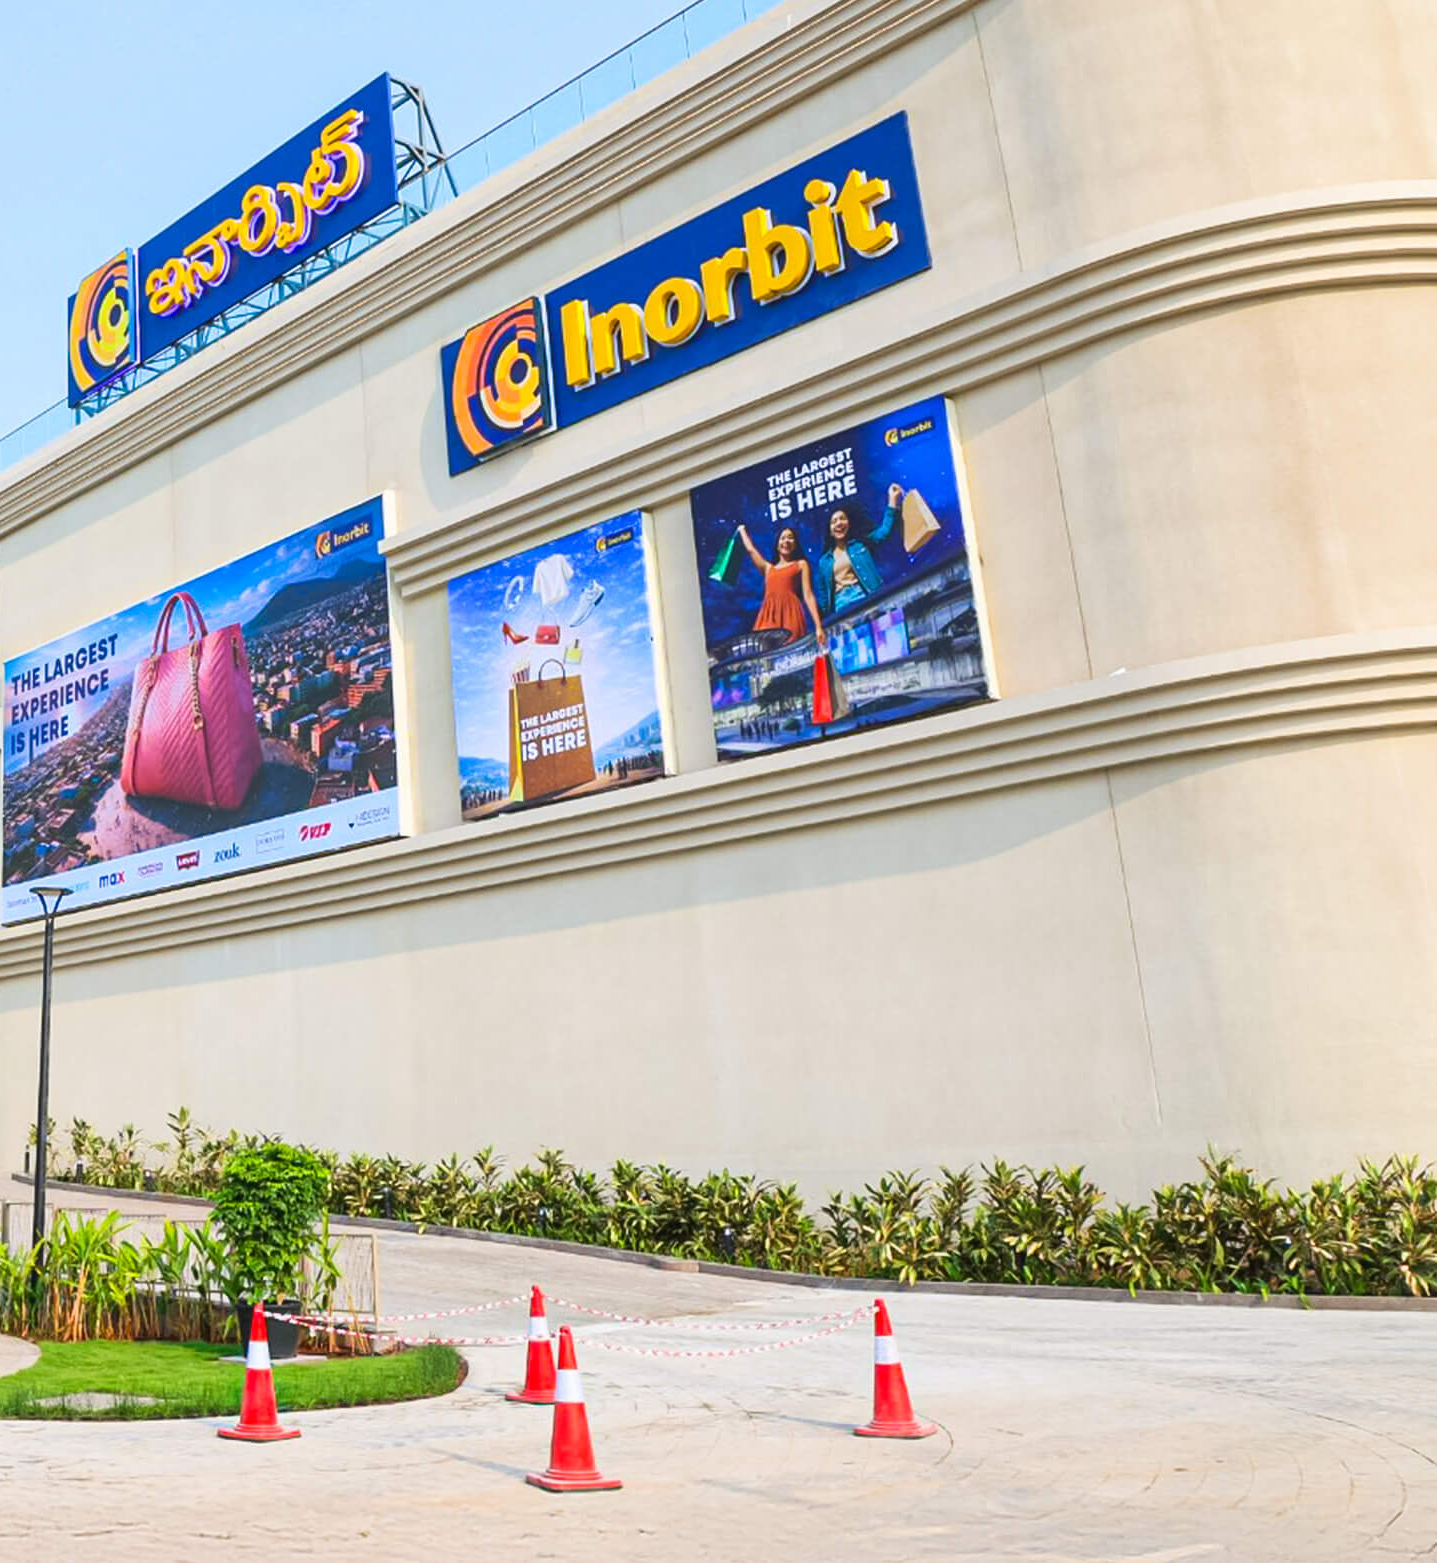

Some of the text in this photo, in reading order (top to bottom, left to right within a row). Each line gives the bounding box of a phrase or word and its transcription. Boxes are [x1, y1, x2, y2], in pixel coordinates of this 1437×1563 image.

[146, 109, 364, 316] ఇనార్బిట్
[561, 169, 896, 391] Inorbit
[767, 448, 852, 488] THE LARGEST
[768, 460, 854, 501] EXPERIENCE
[770, 474, 857, 522] IS HERE
[11, 633, 118, 696] THE LARGEST
[11, 668, 109, 726] EXPERIENCE
[521, 703, 583, 730] THE LARGEST
[11, 715, 69, 755] IS HERE
[521, 716, 585, 742] EXPERIENCE
[522, 729, 587, 762] IS HERE
[99, 871, 125, 889] max
